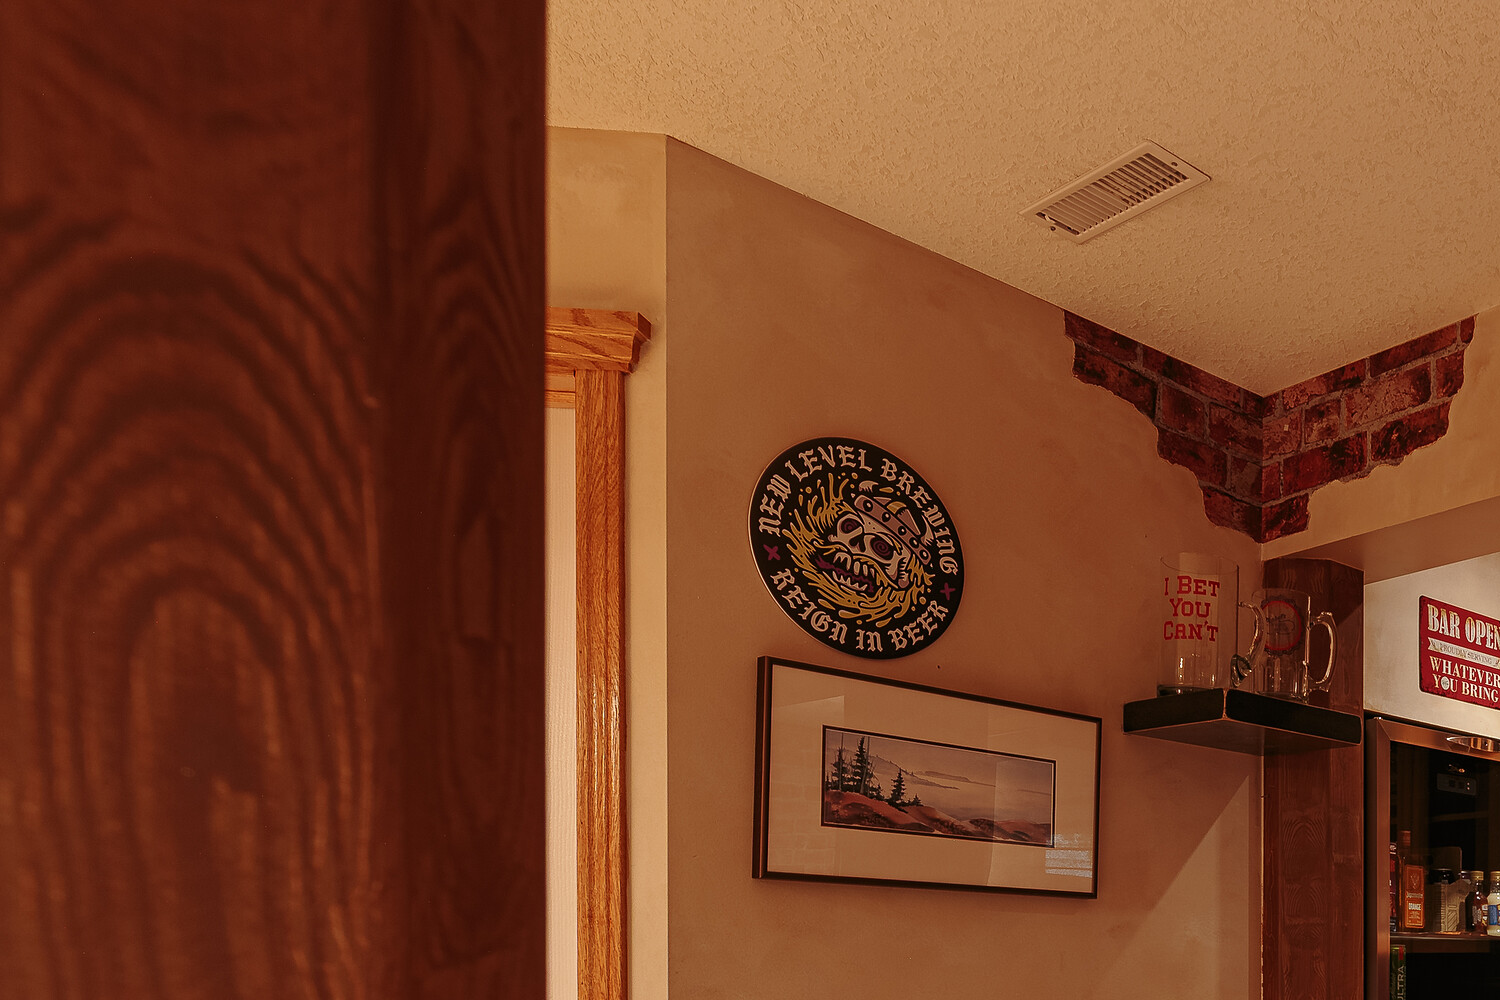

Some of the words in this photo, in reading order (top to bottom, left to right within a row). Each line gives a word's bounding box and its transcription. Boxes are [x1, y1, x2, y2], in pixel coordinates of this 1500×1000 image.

[758, 474, 792, 538] NEW
[785, 445, 873, 482] LEVEL
[880, 458, 959, 576] BREWING
[1164, 577, 1169, 596] I
[1177, 575, 1220, 597] BET
[770, 568, 848, 644] REIGN
[856, 628, 883, 652] IN
[887, 599, 949, 651] BEER
[1169, 598, 1211, 618] YOU
[1427, 604, 1460, 639] BAR
[1163, 620, 1219, 642] CAN'T
[1432, 673, 1458, 693] YOU
[1462, 681, 1499, 703] BRING
